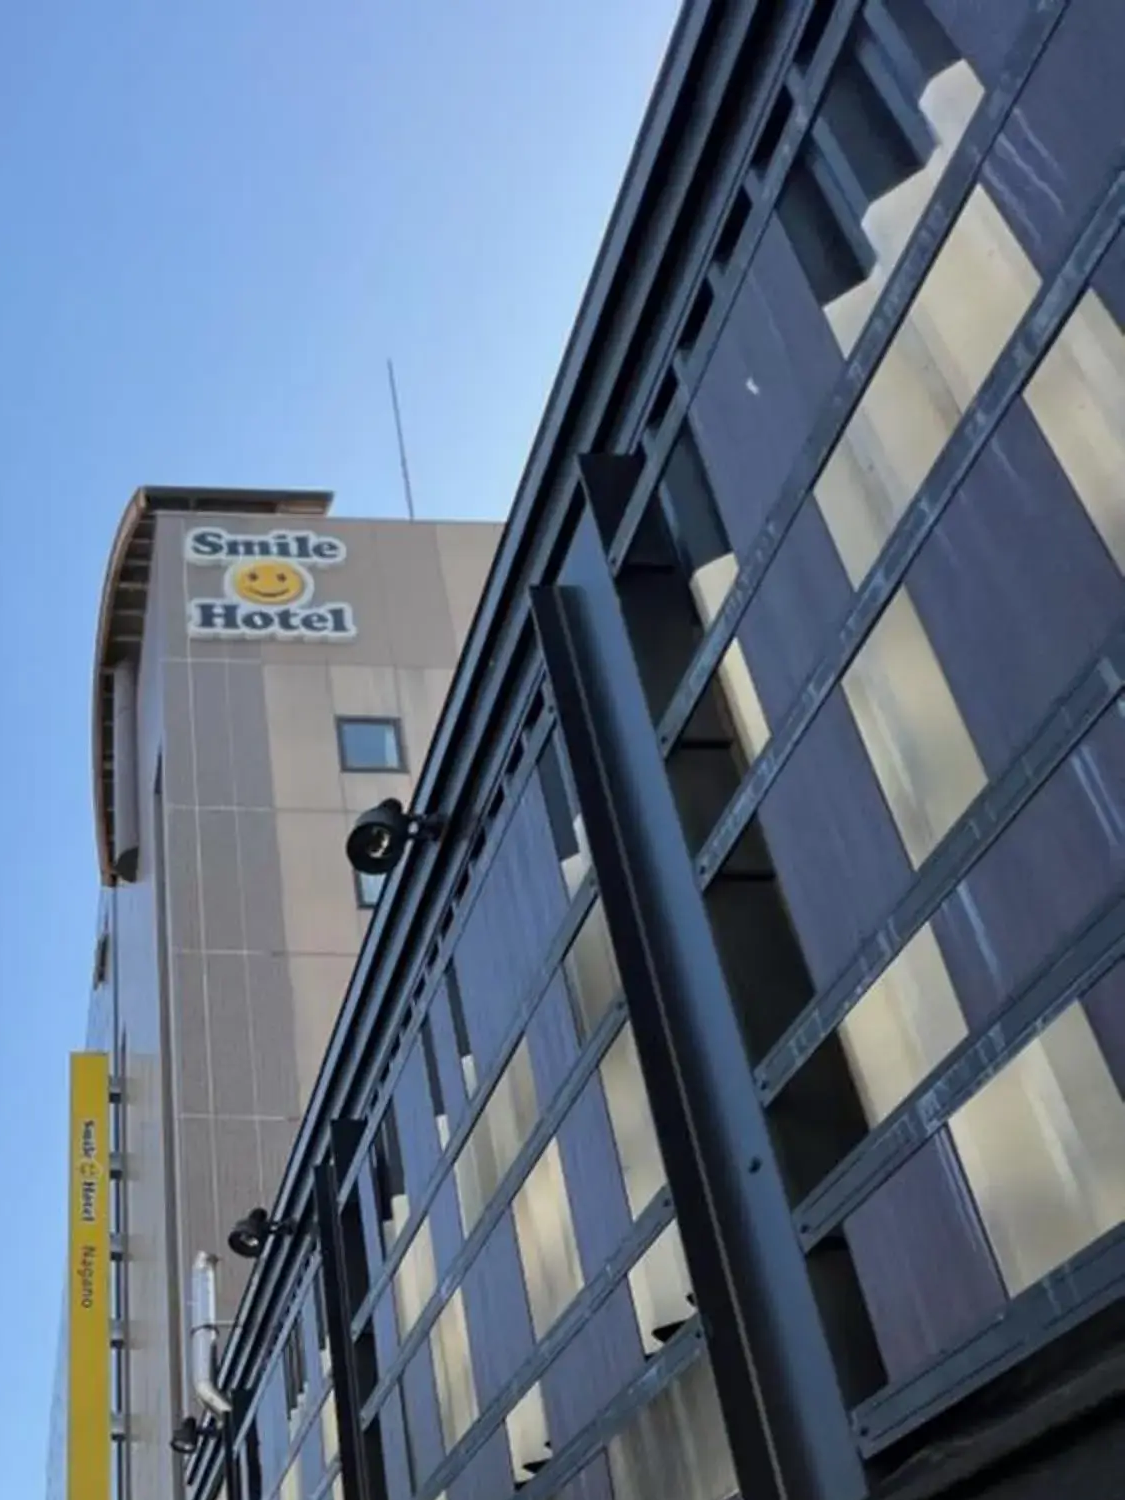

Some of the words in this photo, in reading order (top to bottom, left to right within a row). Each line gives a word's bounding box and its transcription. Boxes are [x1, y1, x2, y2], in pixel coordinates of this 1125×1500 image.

[189, 529, 341, 560] Smile
[194, 602, 351, 633] Hotel
[78, 1246, 96, 1308] Nagano
